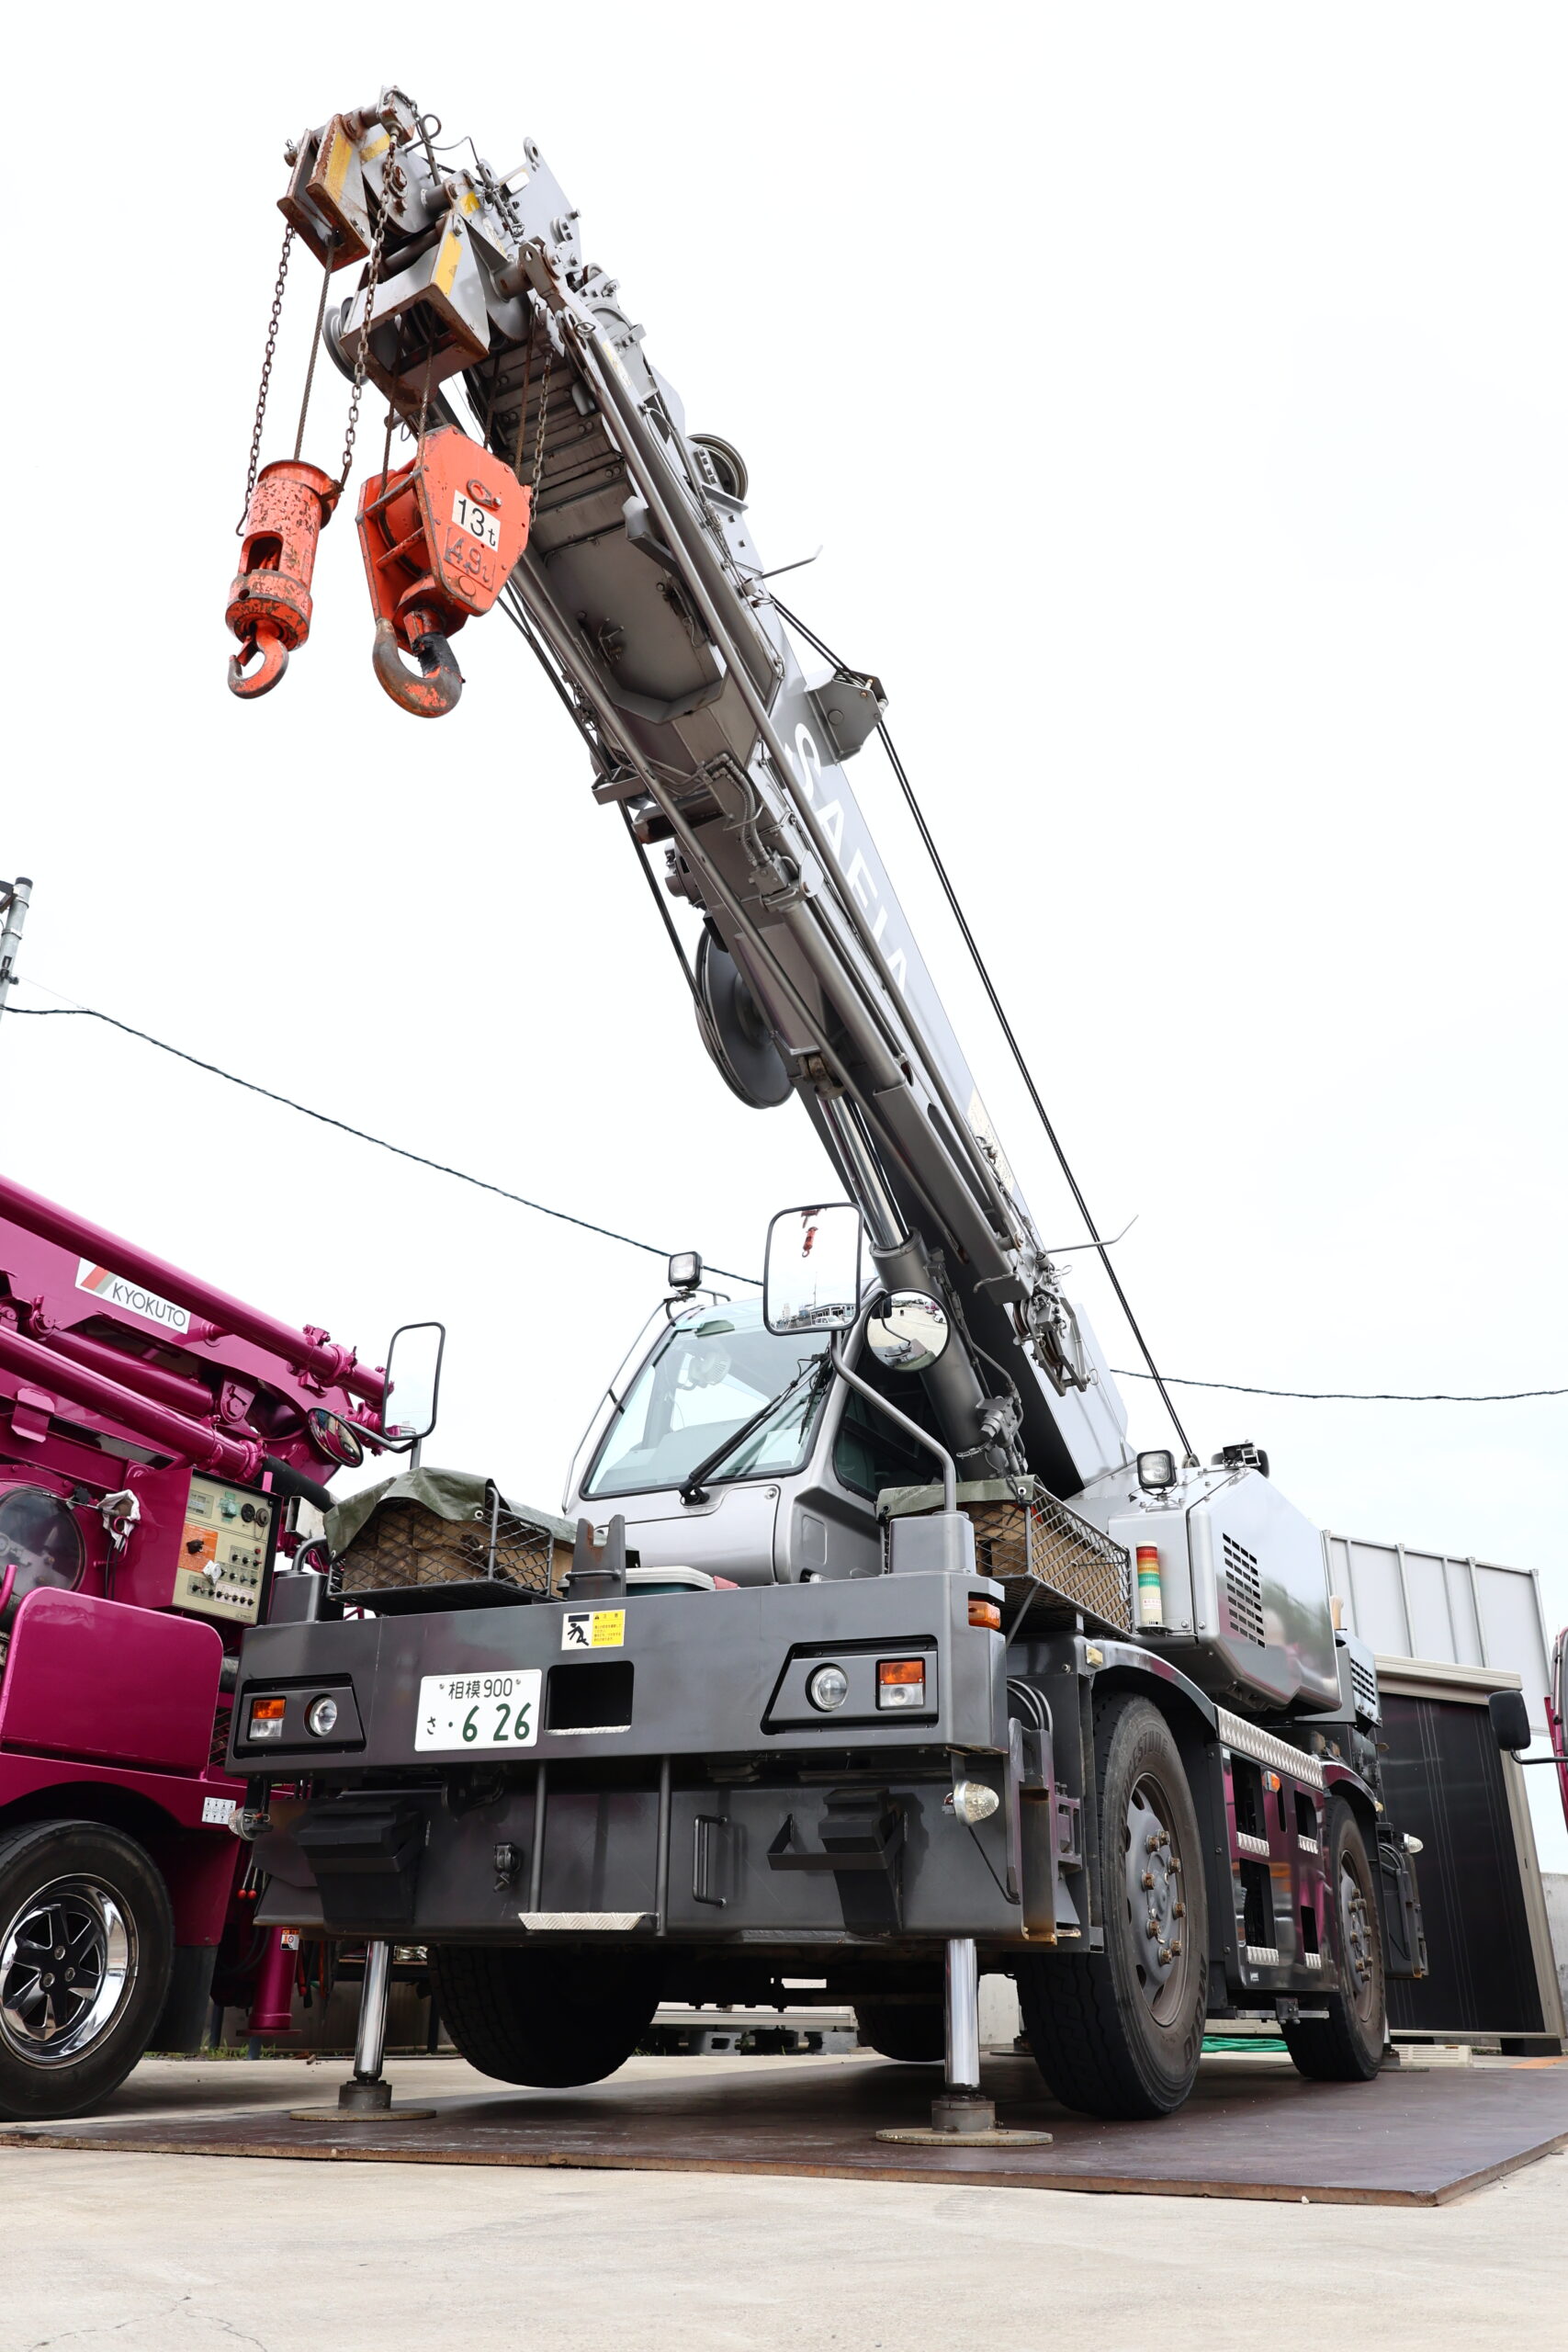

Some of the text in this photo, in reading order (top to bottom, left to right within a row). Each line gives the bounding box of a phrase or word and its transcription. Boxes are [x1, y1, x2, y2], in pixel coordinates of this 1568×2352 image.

[458, 499, 496, 547] 13t
[112, 1283, 186, 1327] KYOKUTO
[427, 1716, 436, 1736] さ
